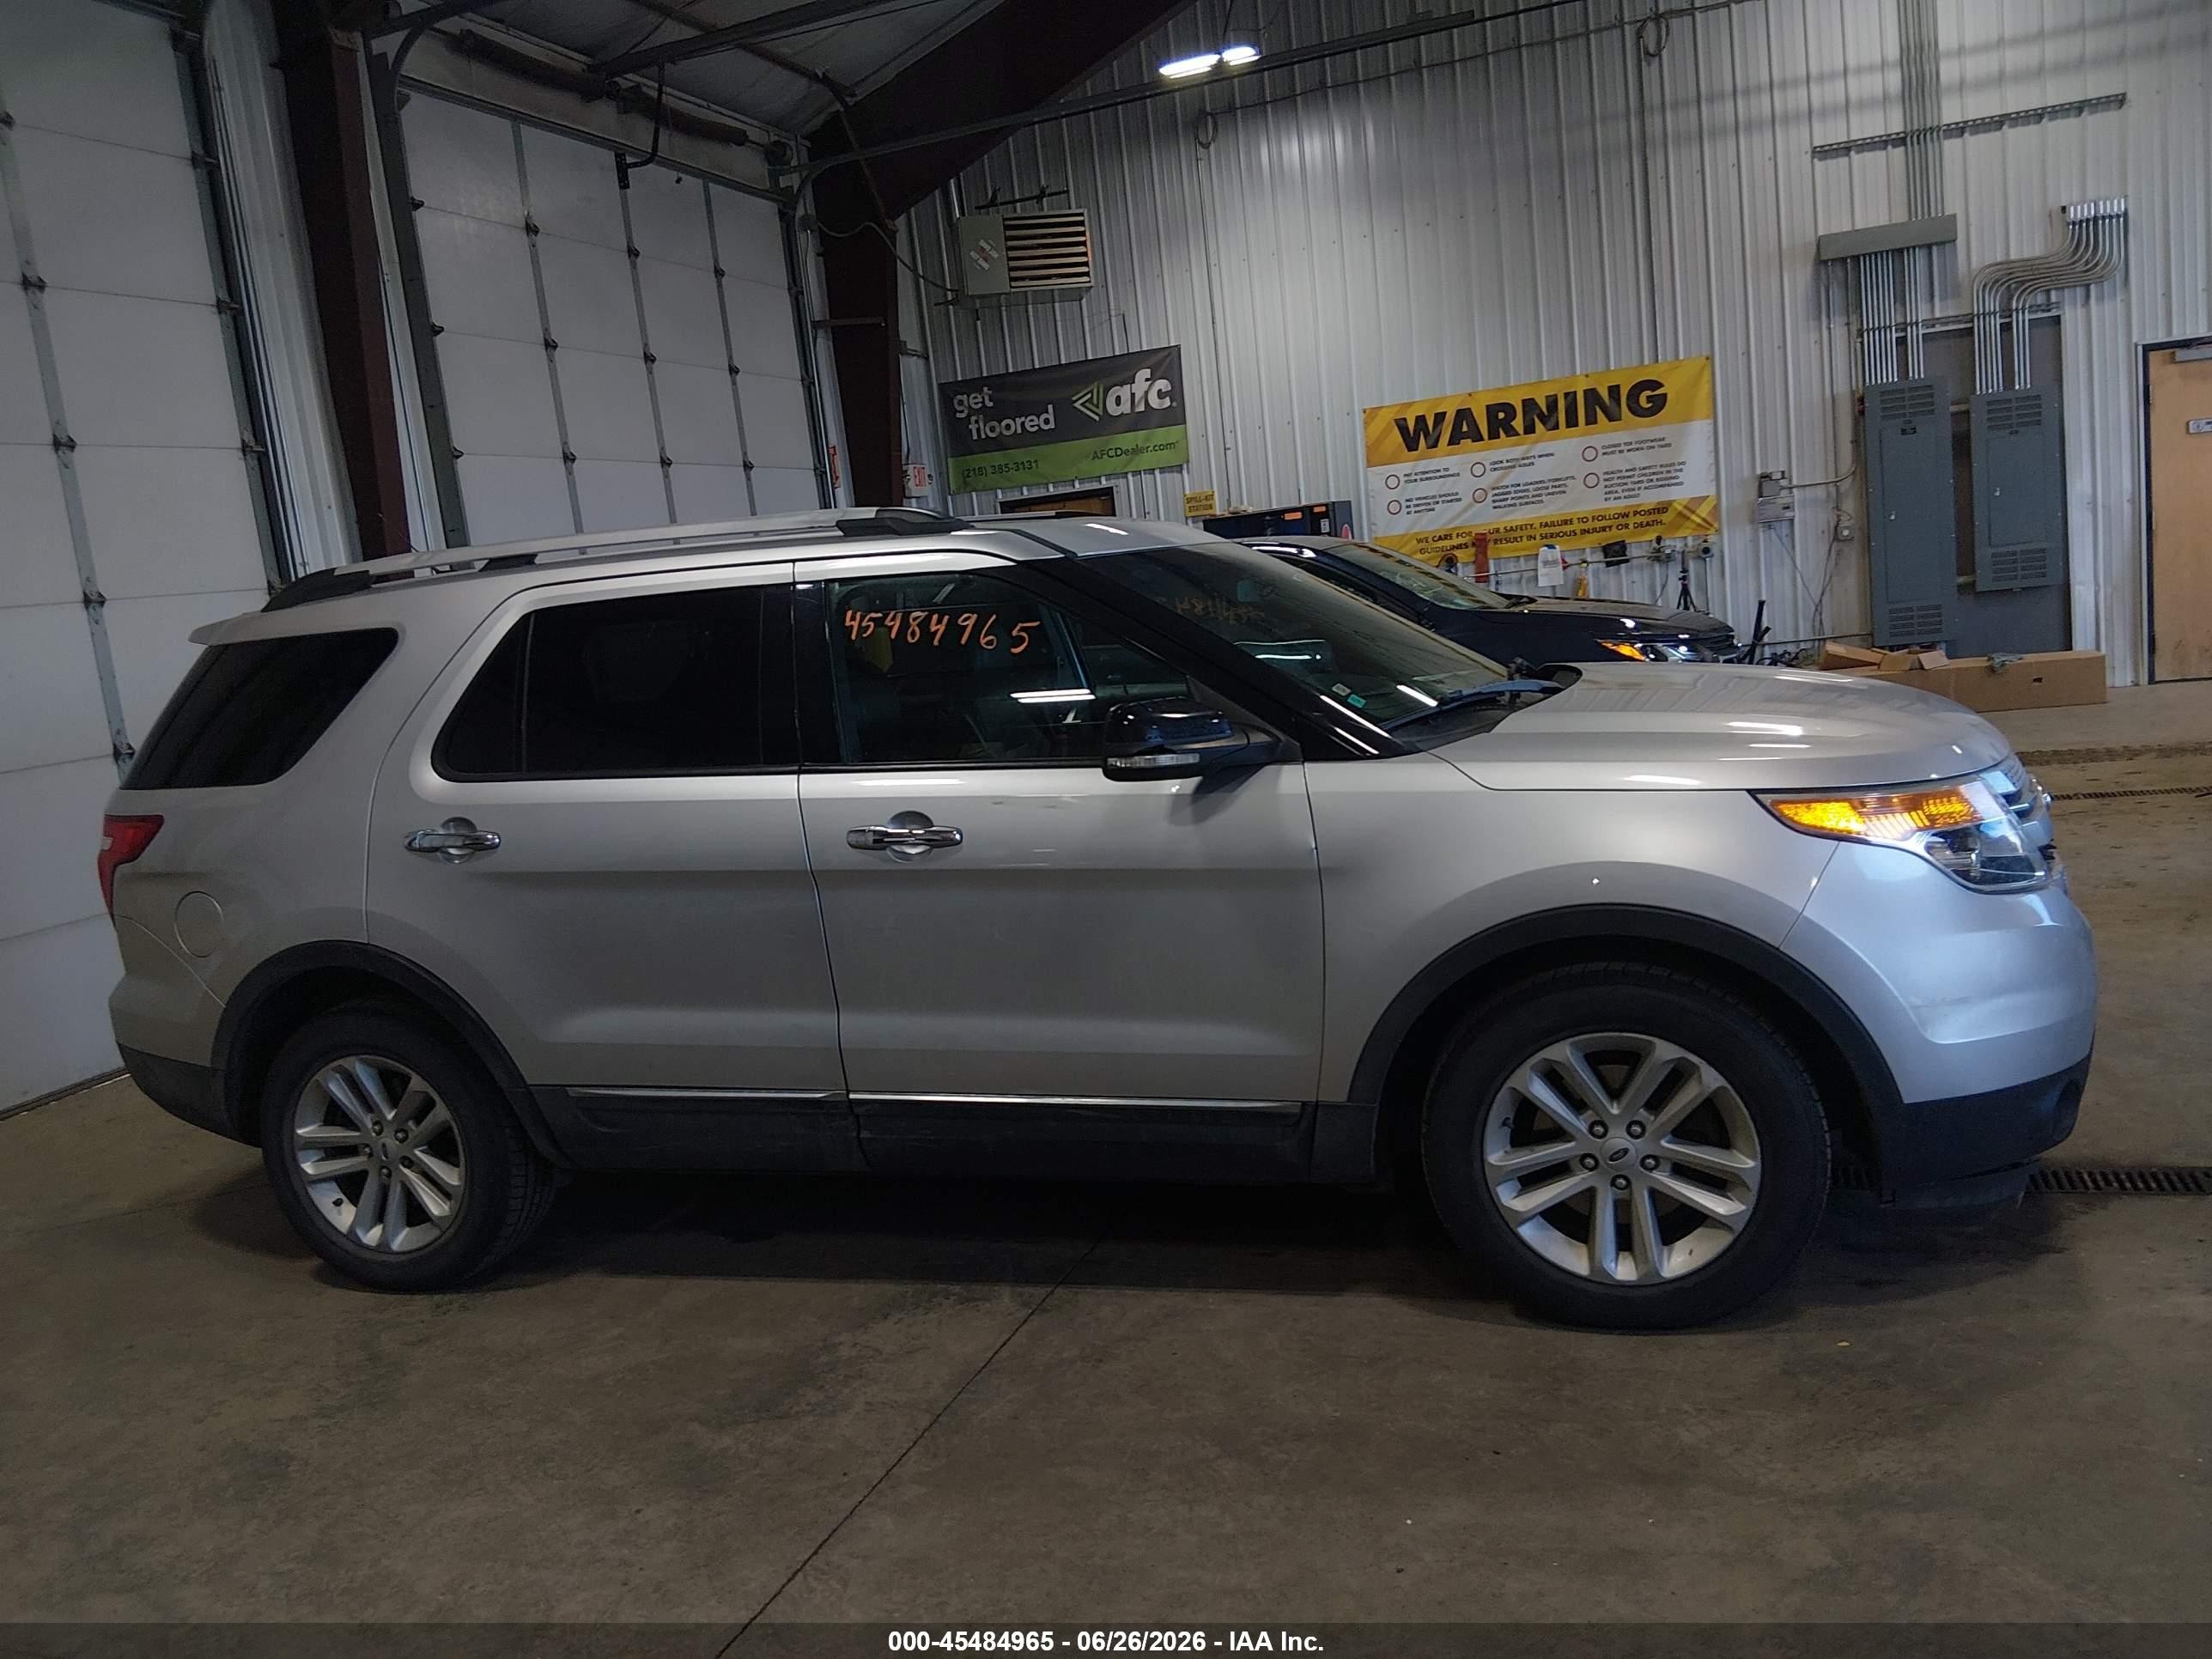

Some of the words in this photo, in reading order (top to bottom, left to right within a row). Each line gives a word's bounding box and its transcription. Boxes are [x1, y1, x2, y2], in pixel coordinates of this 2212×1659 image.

[952, 386, 994, 418] get
[1105, 368, 1172, 416] afc
[968, 404, 1056, 441] floored
[1394, 378, 1668, 453] WARNING
[1091, 441, 1176, 461] AFCDealer.com
[961, 465, 988, 481] (218)
[990, 459, 1040, 475] 385-3131
[1415, 536, 1430, 544] WE
[1431, 533, 1454, 543] CARE
[1503, 522, 1536, 533] SAFETY.
[1539, 517, 1574, 529] FAILURE
[1591, 510, 1631, 523] FOLLOW
[1632, 507, 1669, 518] POSTED
[1419, 542, 1469, 556] GUIDELINES
[1493, 534, 1524, 545] RESULT
[1526, 533, 1537, 542] IN
[1539, 529, 1578, 541] SERIOUS
[1580, 525, 1614, 536] INJURY
[1633, 519, 1667, 530] DEATH.
[844, 609, 1041, 653] 45484965
